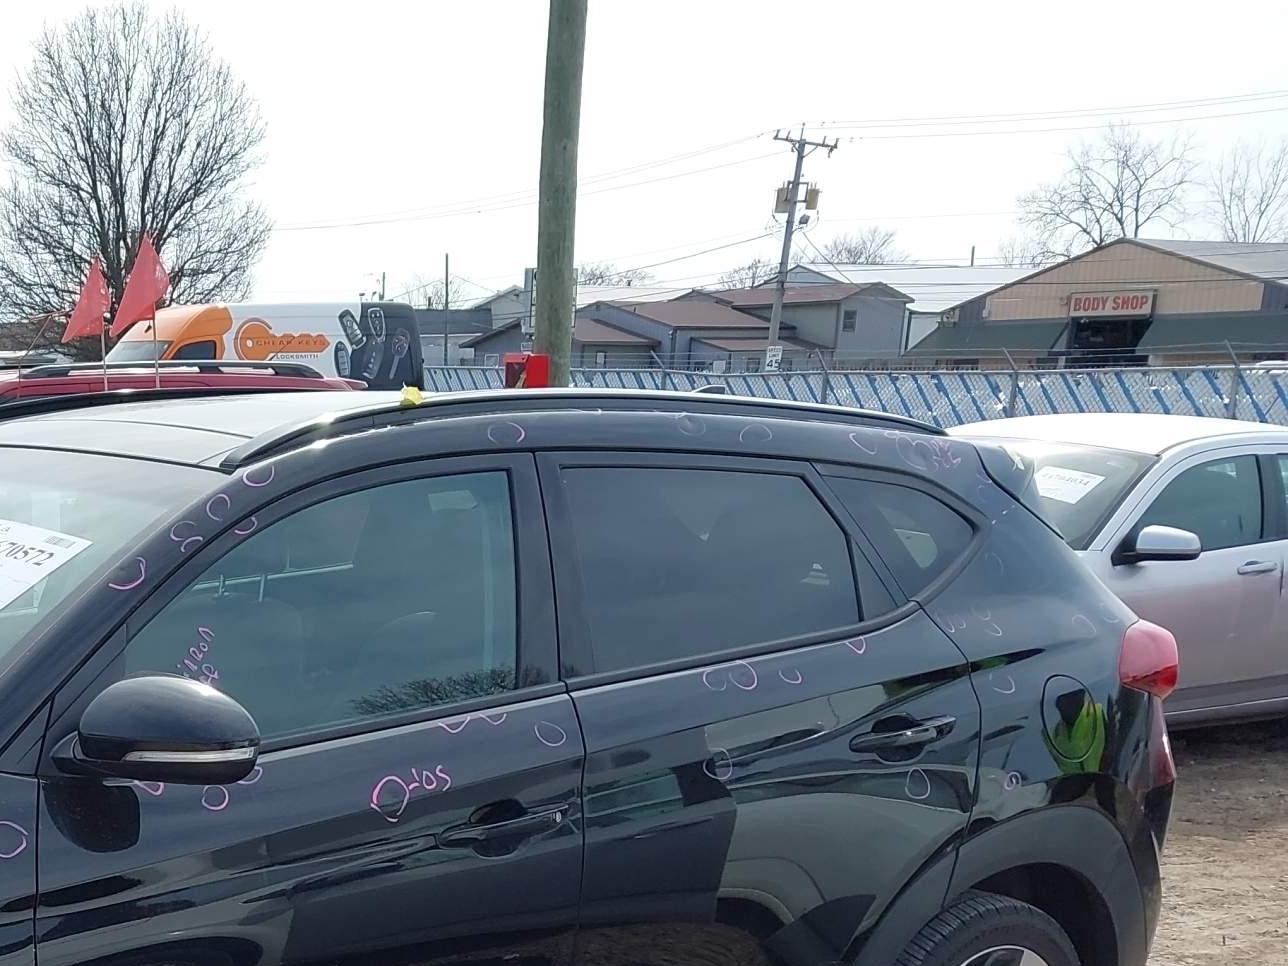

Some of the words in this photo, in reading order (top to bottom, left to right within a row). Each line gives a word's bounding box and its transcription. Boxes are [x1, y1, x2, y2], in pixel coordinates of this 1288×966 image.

[1073, 296, 1110, 312] BODY
[1112, 294, 1149, 311] SHOP
[767, 359, 781, 369] 45
